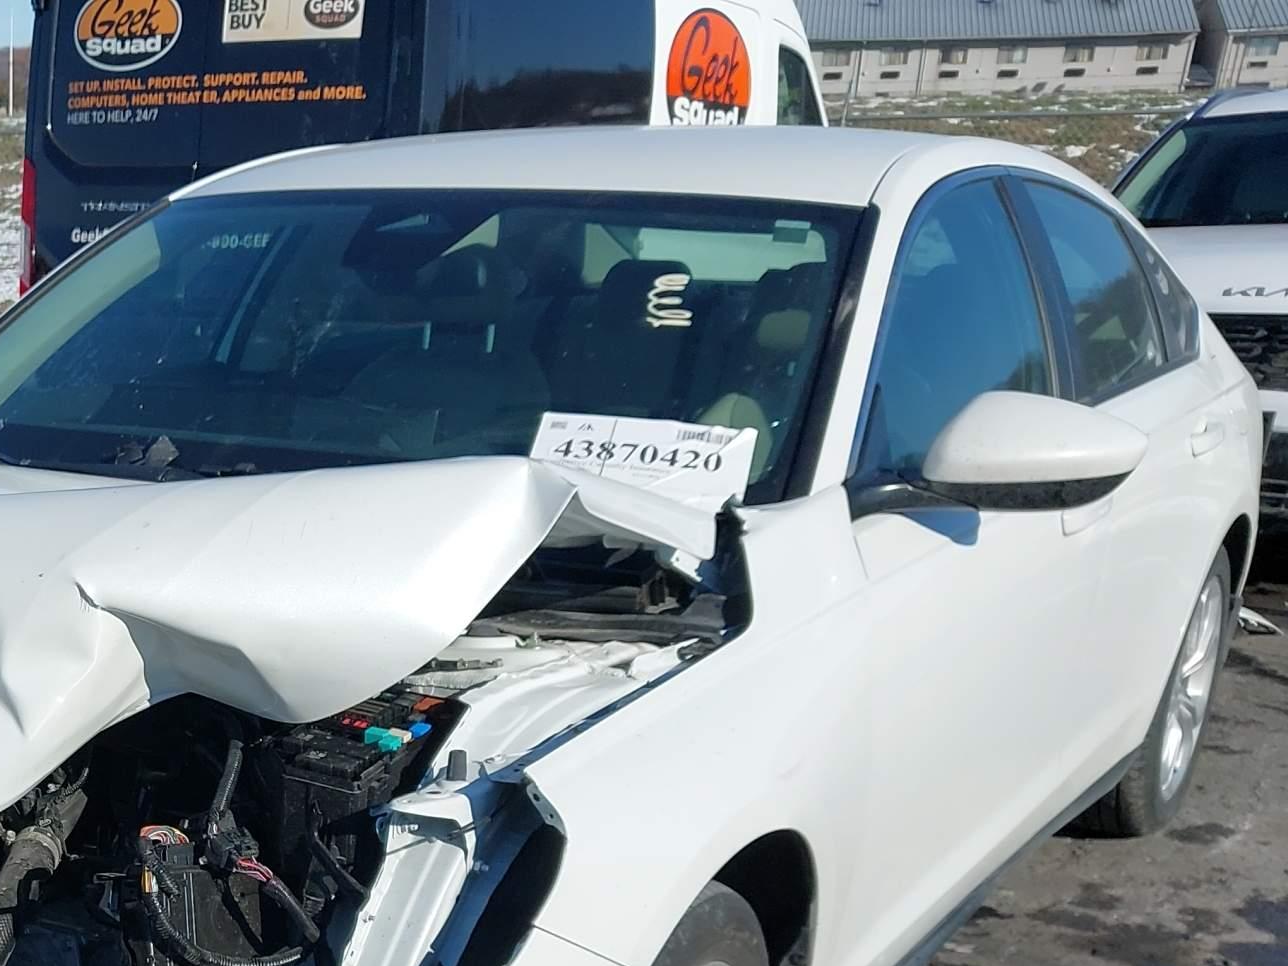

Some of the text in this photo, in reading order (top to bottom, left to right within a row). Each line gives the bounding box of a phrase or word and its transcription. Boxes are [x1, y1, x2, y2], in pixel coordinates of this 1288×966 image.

[228, 0, 268, 12] BEST
[309, 0, 355, 14] Geek
[90, 0, 160, 37] Geek
[230, 12, 265, 30] BUY
[681, 15, 739, 105] Geek
[68, 81, 85, 94] SET
[103, 78, 146, 91] INSTALL.
[147, 75, 199, 90] PROTECT.
[203, 72, 259, 87] SUPPORT.
[261, 70, 308, 85] REPAIR.
[67, 94, 130, 110] COMPUTERS,
[132, 91, 165, 107] HOME
[222, 87, 295, 102] APPLIANCES
[297, 86, 321, 100] and
[322, 85, 367, 100] MORE.
[66, 110, 91, 125] HERE
[93, 110, 106, 124] TO
[135, 107, 160, 122] 24/7
[554, 437, 722, 473] 43870420
